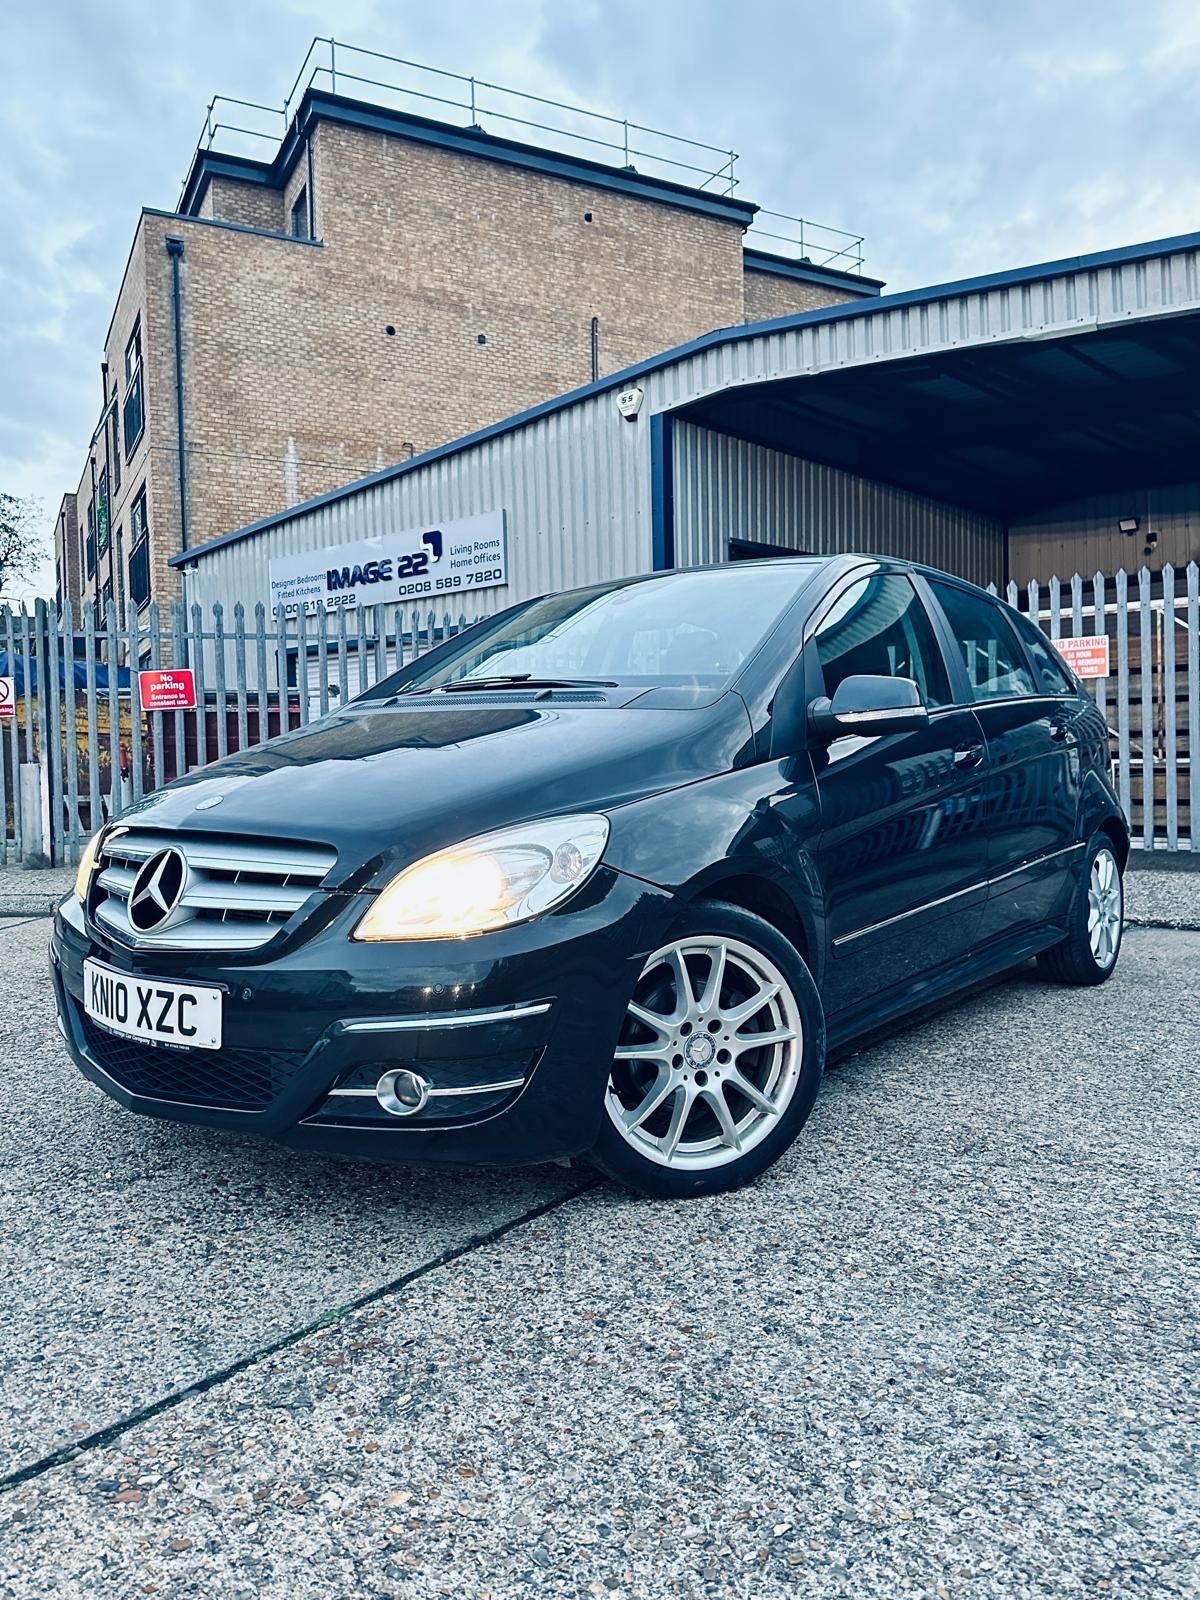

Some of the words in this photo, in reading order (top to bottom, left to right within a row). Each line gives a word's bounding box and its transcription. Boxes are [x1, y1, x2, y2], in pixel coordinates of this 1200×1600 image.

[450, 544, 472, 556] Living
[473, 539, 500, 552] Rooms
[450, 557, 472, 568] Home
[473, 552, 501, 565] Offices
[326, 559, 393, 591] IMAGE
[397, 552, 429, 578] 22
[272, 579, 296, 590] Designer
[297, 573, 326, 584] Bedrooms
[399, 580, 431, 595] 0208
[436, 576, 461, 589] 589
[466, 568, 502, 584] 7820
[277, 588, 295, 599] Fitted
[296, 586, 321, 597] Kitchens
[272, 603, 299, 616] 000
[327, 594, 356, 607] 2222
[1068, 638, 1106, 648] PARKING
[160, 673, 173, 682] No
[150, 682, 185, 693] parking
[91, 971, 128, 1024] KN10
[137, 986, 197, 1037] XZC
